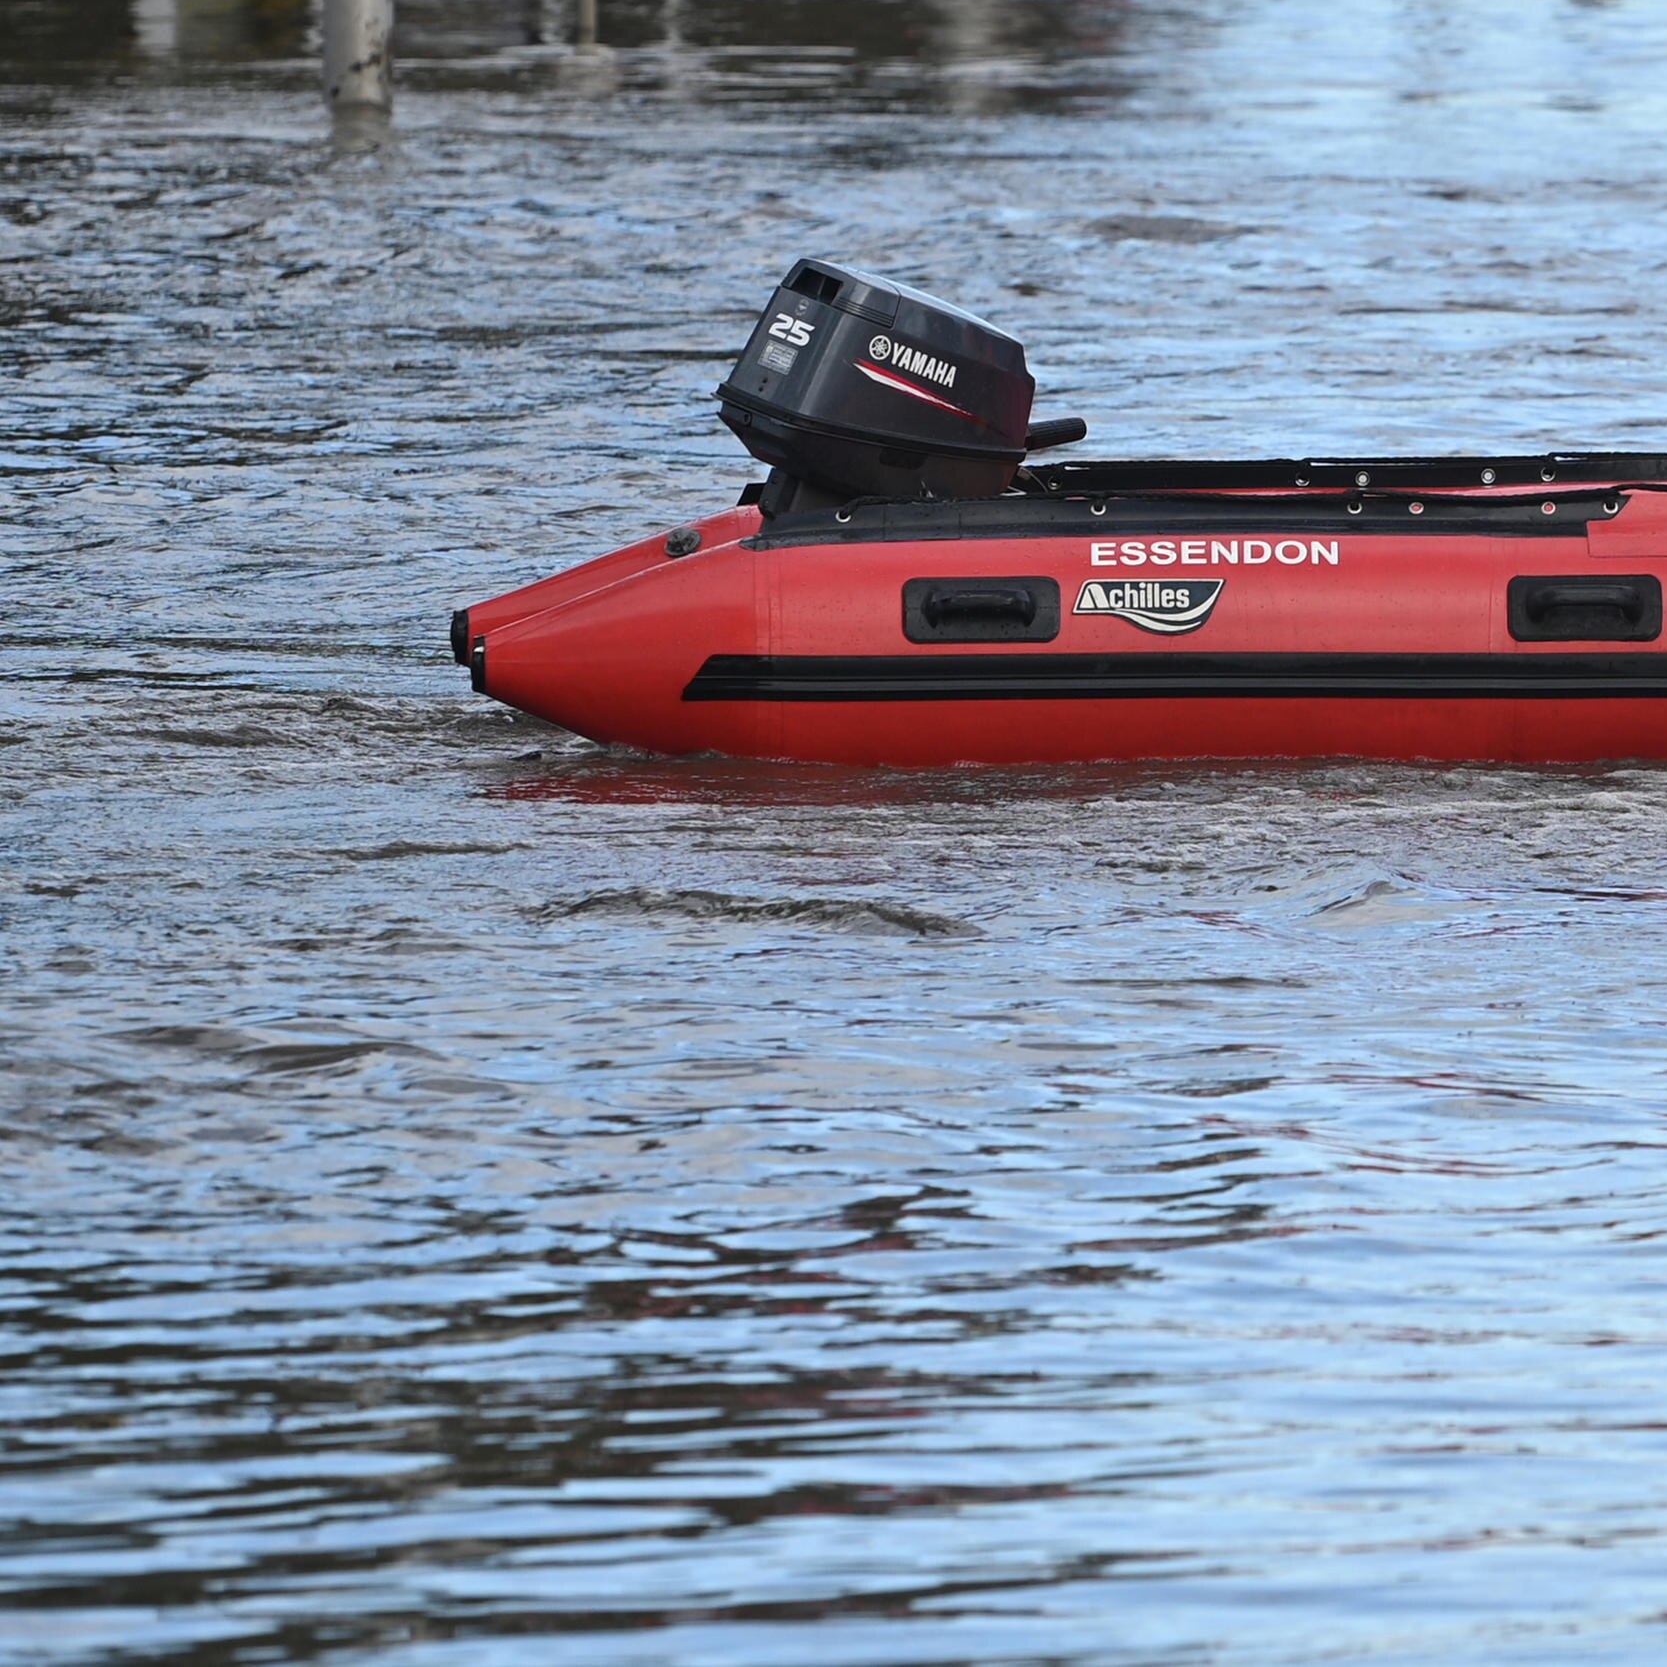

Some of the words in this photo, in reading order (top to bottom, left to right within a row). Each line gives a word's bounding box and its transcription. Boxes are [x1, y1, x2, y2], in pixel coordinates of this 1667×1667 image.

[768, 313, 816, 347] 25
[890, 342, 958, 388] YAMAHA
[1090, 540, 1340, 566] ESSENDON
[1078, 581, 1190, 609] Achilles
